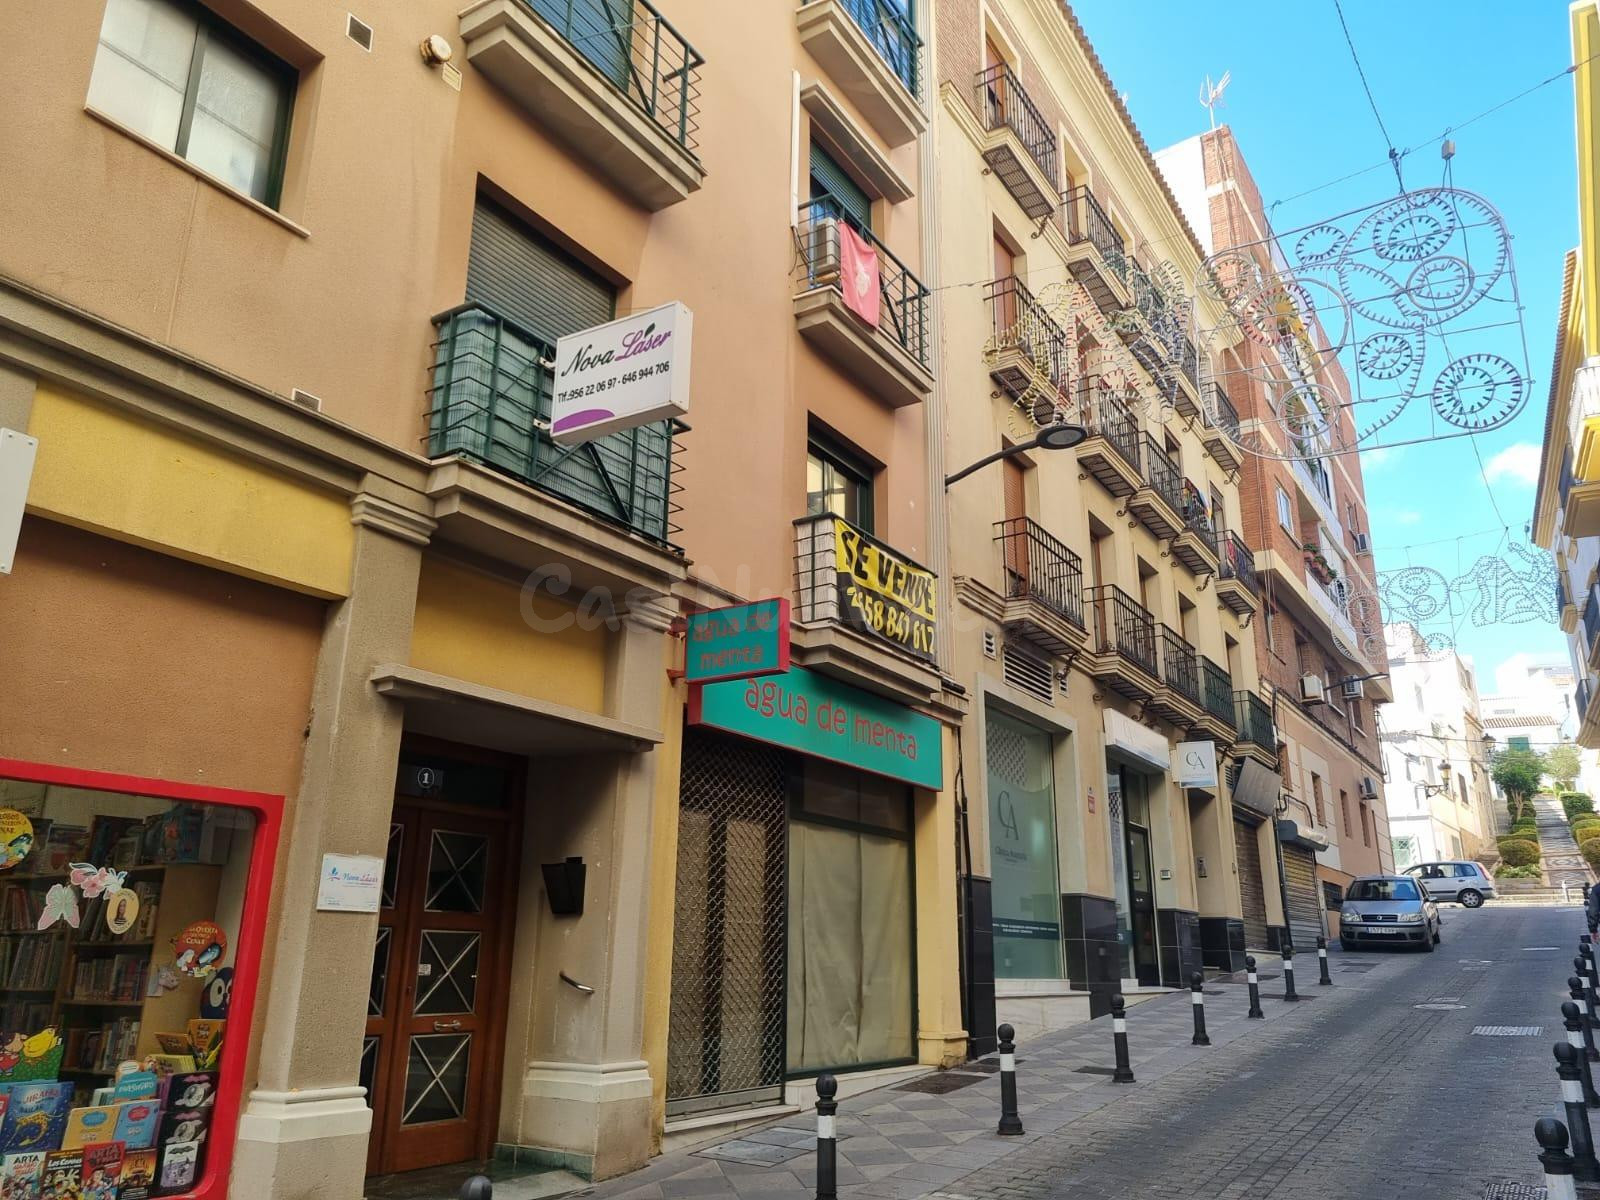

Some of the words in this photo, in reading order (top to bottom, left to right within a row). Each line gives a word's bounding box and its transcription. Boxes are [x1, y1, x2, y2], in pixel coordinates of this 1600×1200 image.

[561, 344, 615, 377] Nova
[585, 384, 595, 396] 22
[596, 380, 606, 392] 06
[607, 377, 617, 389] 97
[622, 370, 637, 384] 646
[638, 366, 653, 380] 944
[655, 360, 670, 375] 706
[841, 530, 873, 580] SE
[877, 550, 934, 616] VENDE
[692, 618, 739, 643] agua
[745, 610, 771, 632] de
[886, 606, 910, 643] 847
[913, 620, 935, 654] 612
[700, 644, 763, 670] menta
[744, 678, 809, 725] agua
[817, 701, 847, 735] de
[854, 711, 918, 761] menta
[13, 1155, 39, 1164] ARTA
